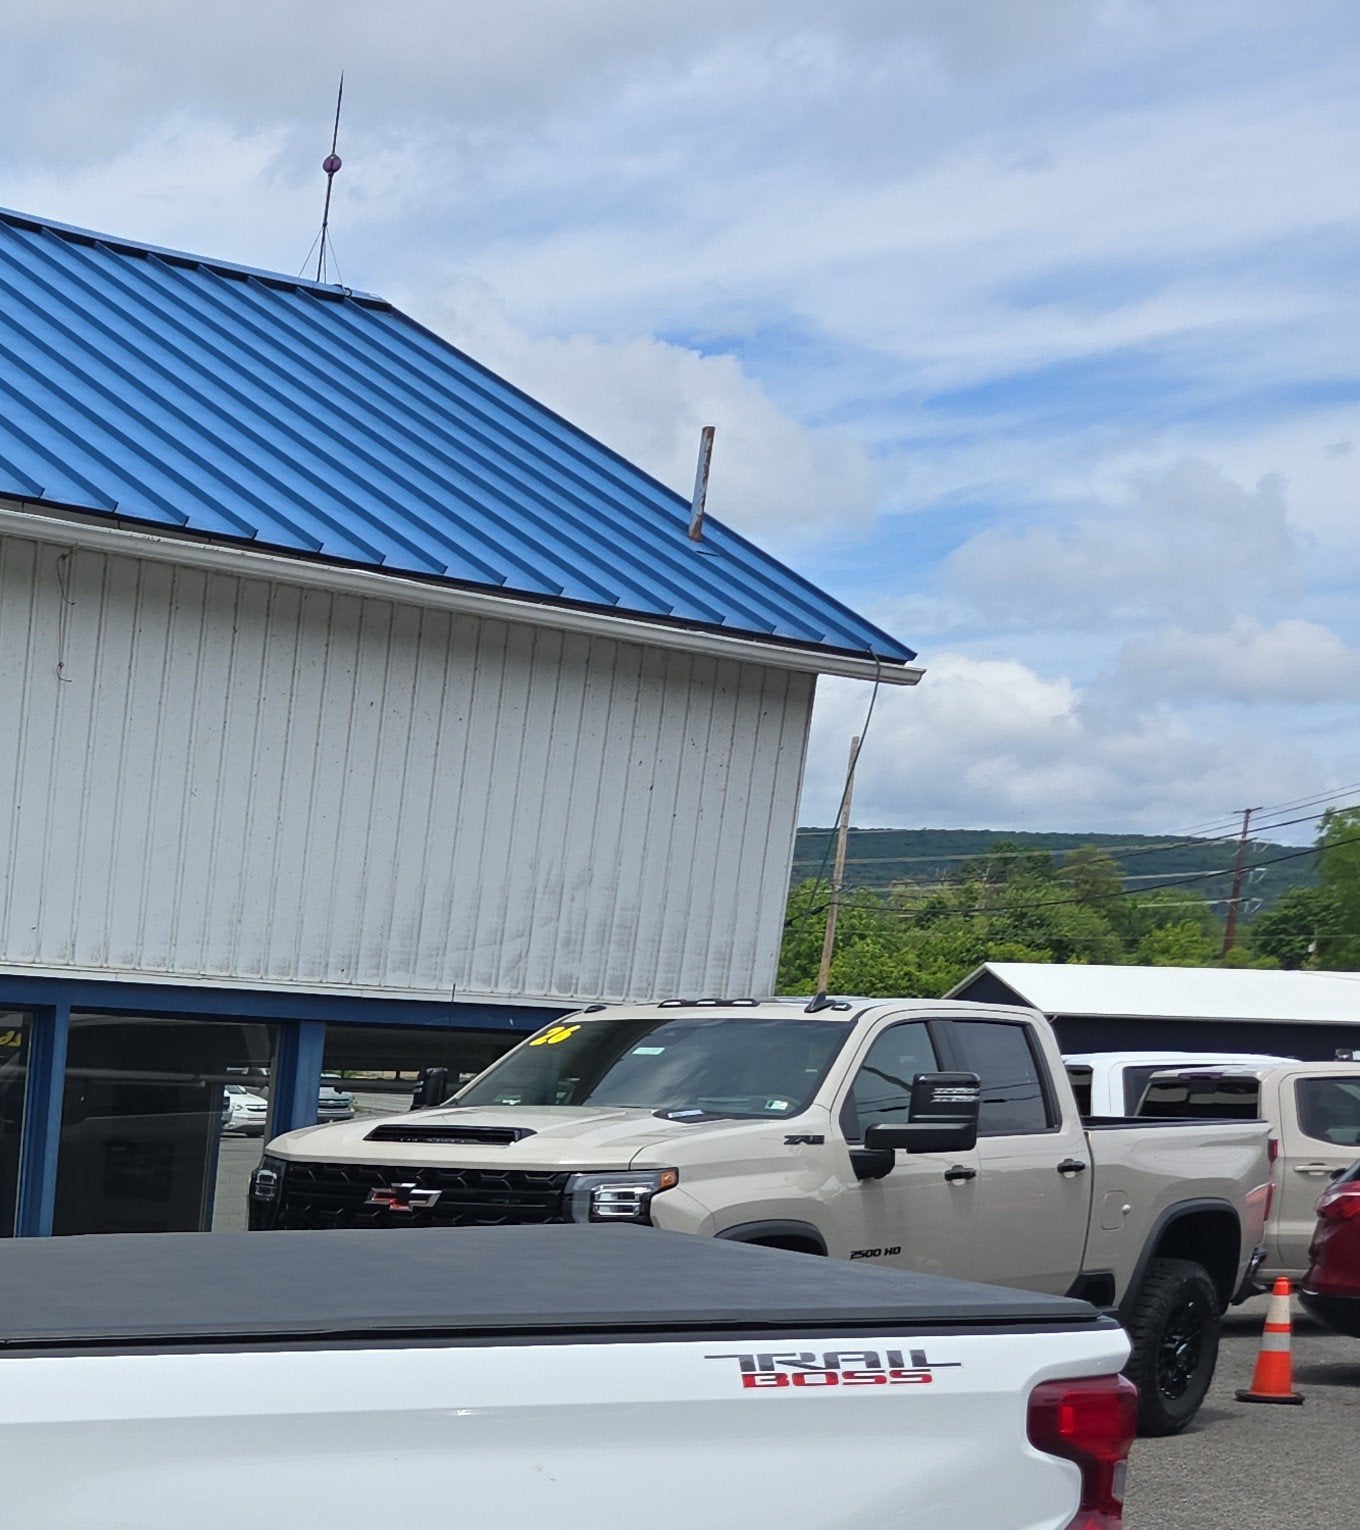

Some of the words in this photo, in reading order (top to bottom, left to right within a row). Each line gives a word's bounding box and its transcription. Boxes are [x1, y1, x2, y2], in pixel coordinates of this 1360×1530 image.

[529, 1024, 581, 1046] 26
[850, 1248, 882, 1260] 2500
[883, 1246, 902, 1256] HD
[704, 1349, 962, 1372] TRAIL
[742, 1368, 933, 1388] BOSS
